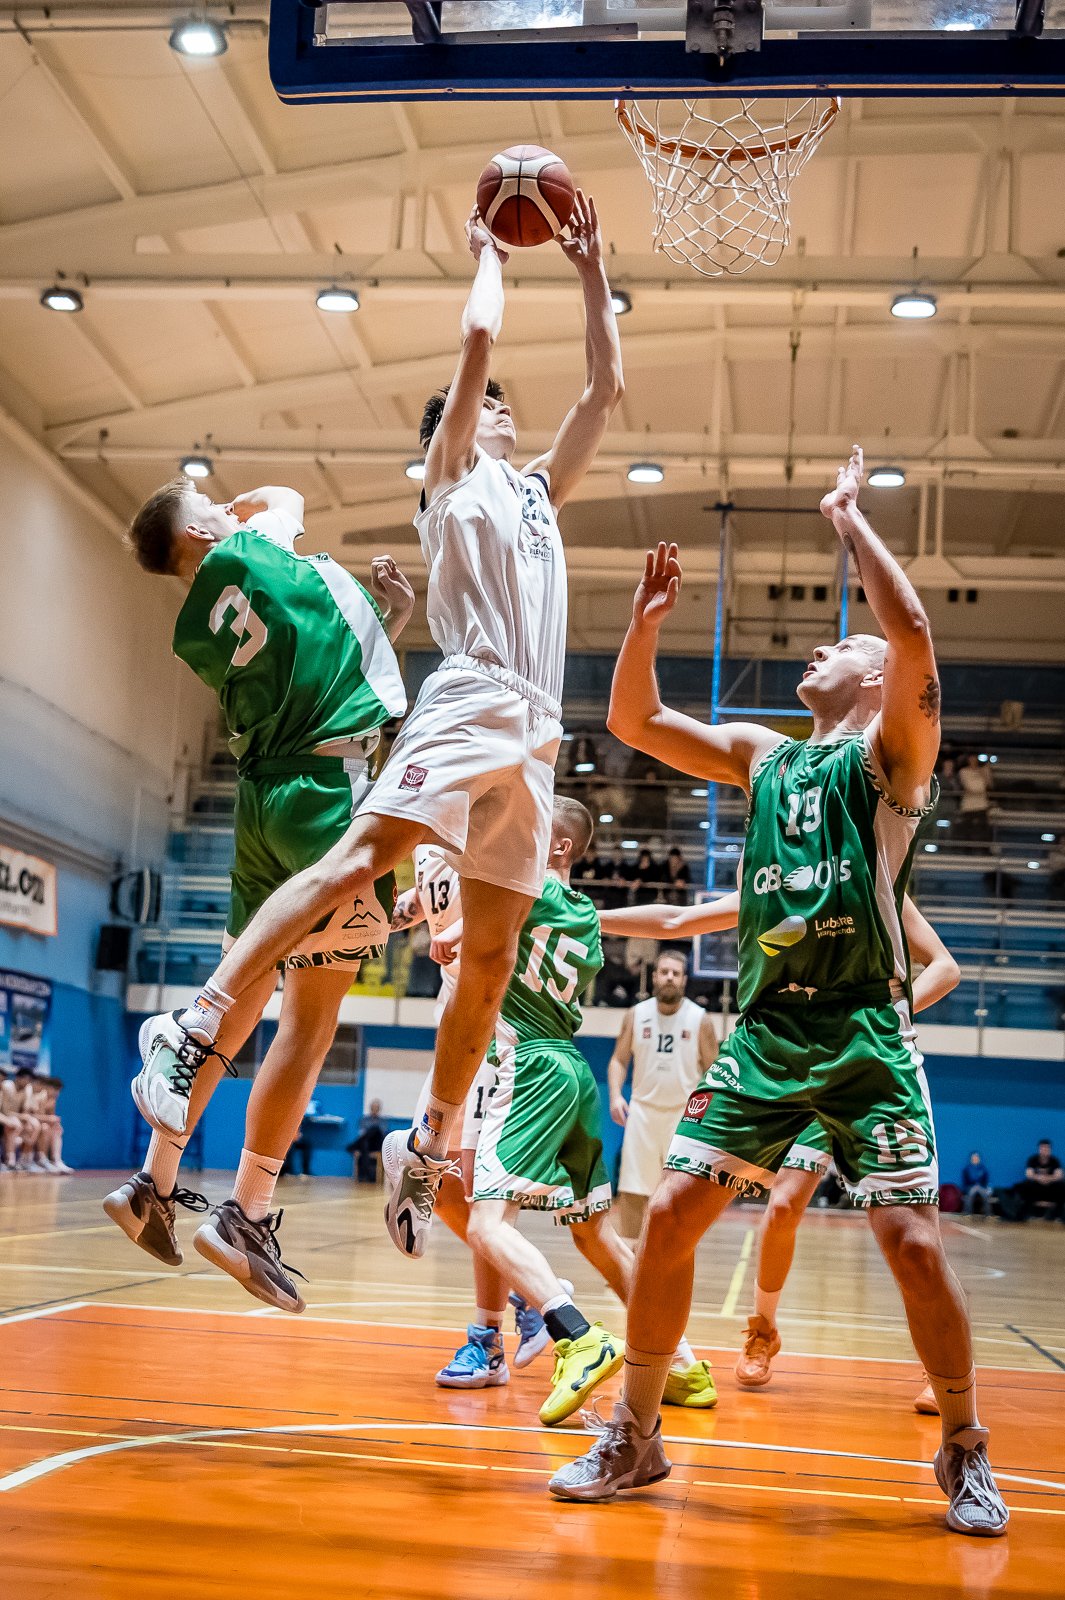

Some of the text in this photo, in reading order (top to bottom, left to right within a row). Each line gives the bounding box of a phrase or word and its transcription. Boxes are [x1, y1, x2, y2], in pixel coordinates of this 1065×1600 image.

[208, 584, 268, 667] 3
[785, 786, 823, 836] 19
[428, 879, 451, 915] 13
[753, 863, 783, 895] Q8
[518, 924, 589, 1004] 15
[656, 1033, 674, 1053] 12
